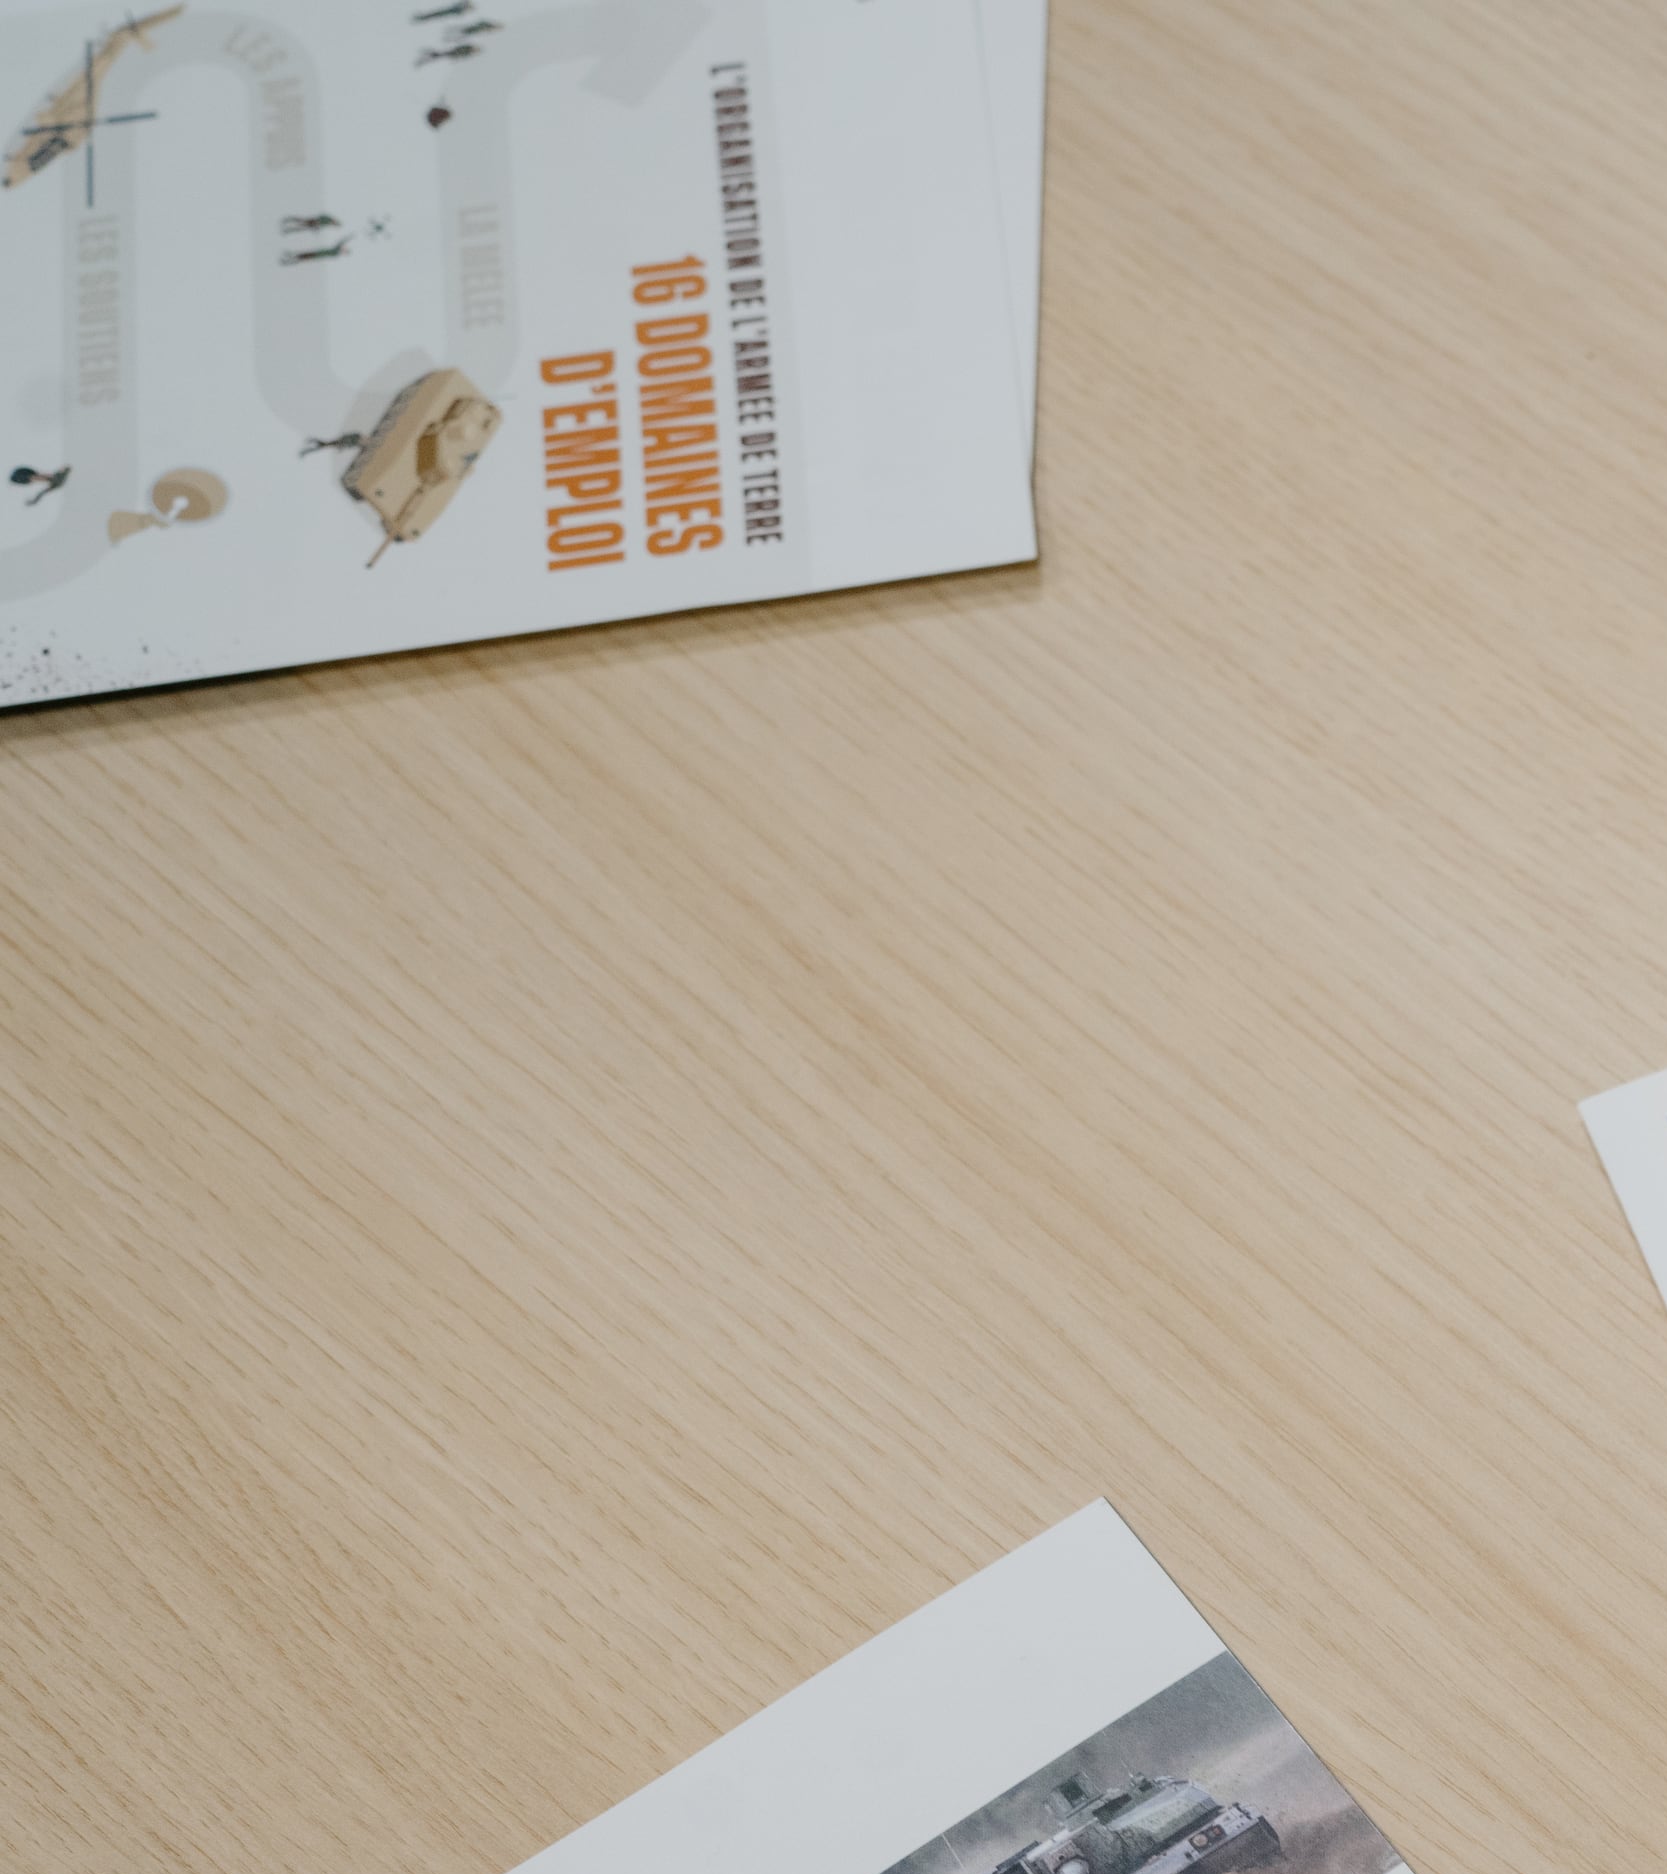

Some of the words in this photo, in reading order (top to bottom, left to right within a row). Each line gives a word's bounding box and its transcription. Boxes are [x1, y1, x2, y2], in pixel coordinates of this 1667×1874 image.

[710, 62, 762, 269] L'ORGANISATION
[630, 254, 708, 306] 16
[729, 279, 766, 309] DE
[540, 350, 626, 574] D'EMPLOI
[634, 312, 724, 557] DOMAINES
[740, 431, 778, 463] DE
[743, 468, 783, 546] TERRE
